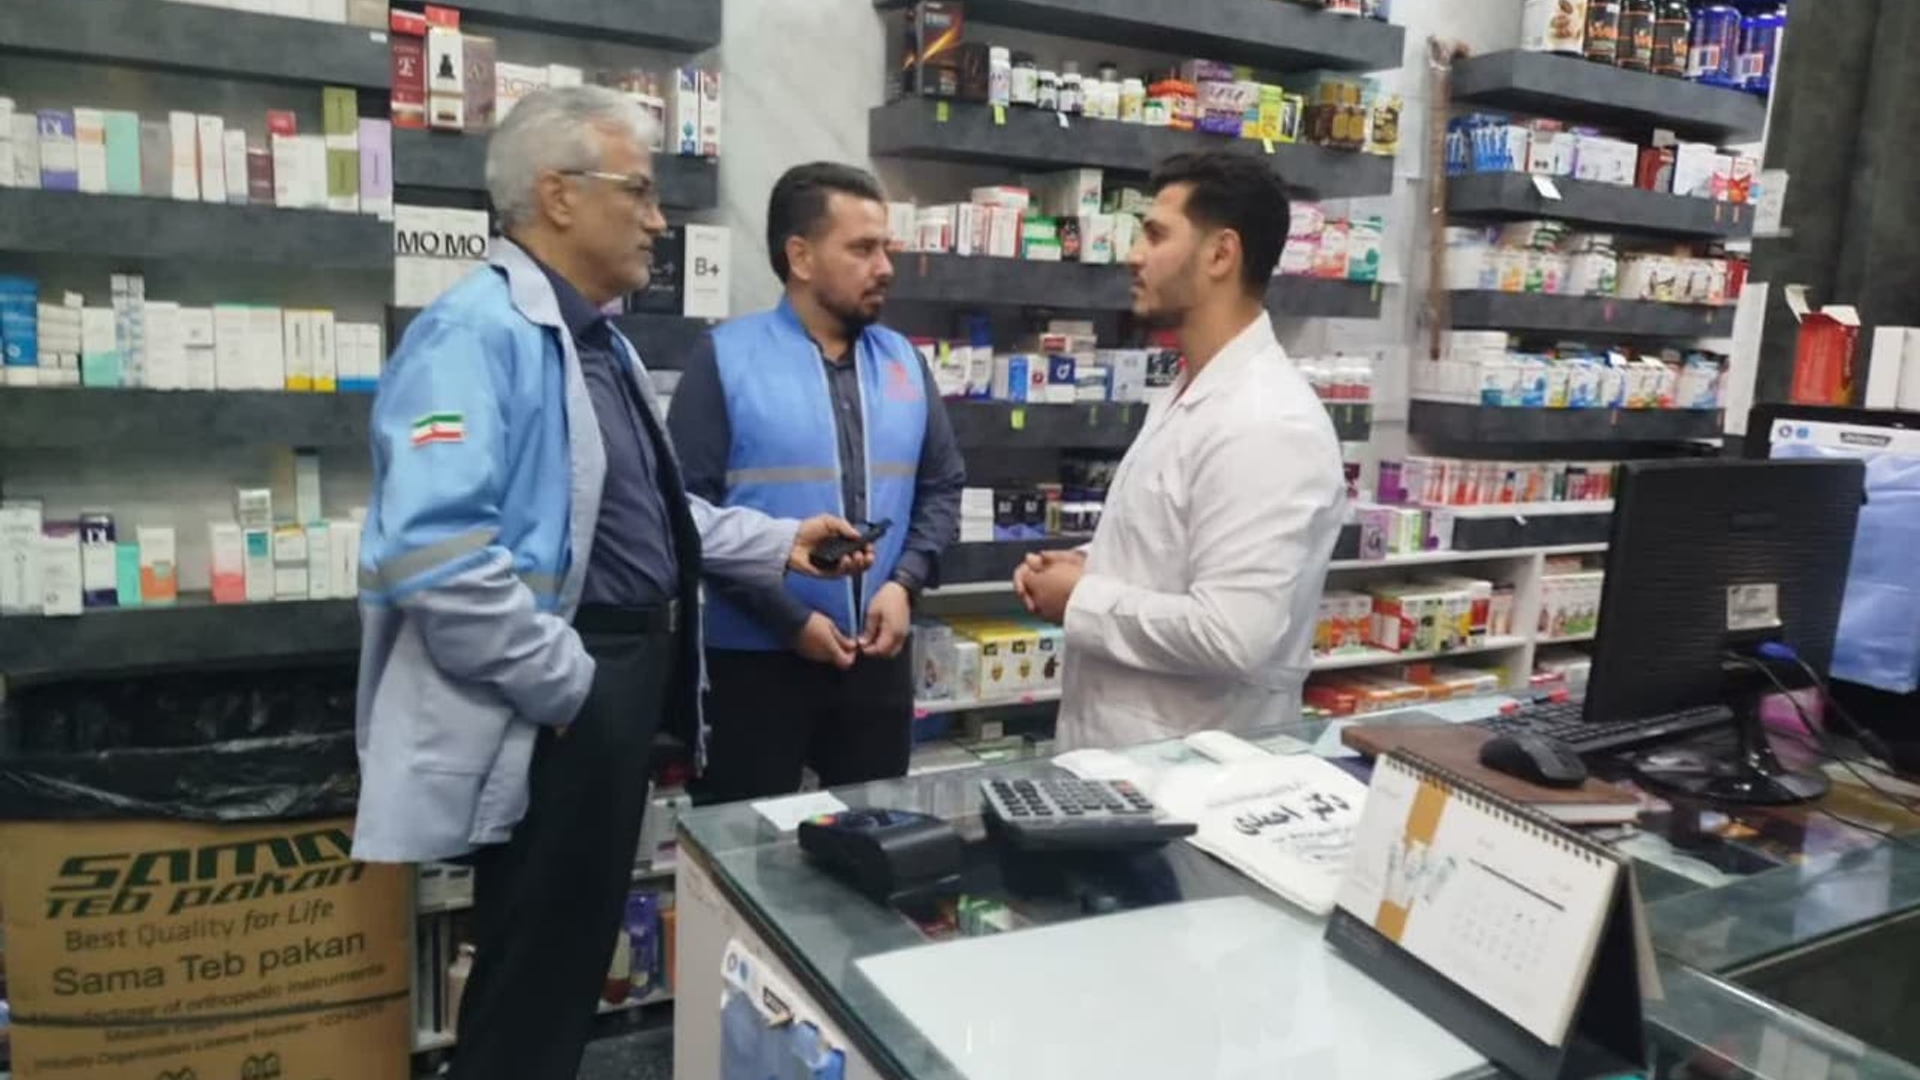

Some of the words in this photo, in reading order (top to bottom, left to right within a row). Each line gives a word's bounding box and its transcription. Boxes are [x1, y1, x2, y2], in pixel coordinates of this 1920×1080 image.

[397, 231, 440, 256] MO
[445, 232, 486, 257] MO
[65, 927, 127, 953] Best
[138, 917, 234, 948] Quality
[243, 908, 280, 933] for
[288, 899, 334, 925] Life
[53, 964, 165, 997] Sama
[181, 951, 245, 983] Teb
[259, 932, 366, 977] pakan
